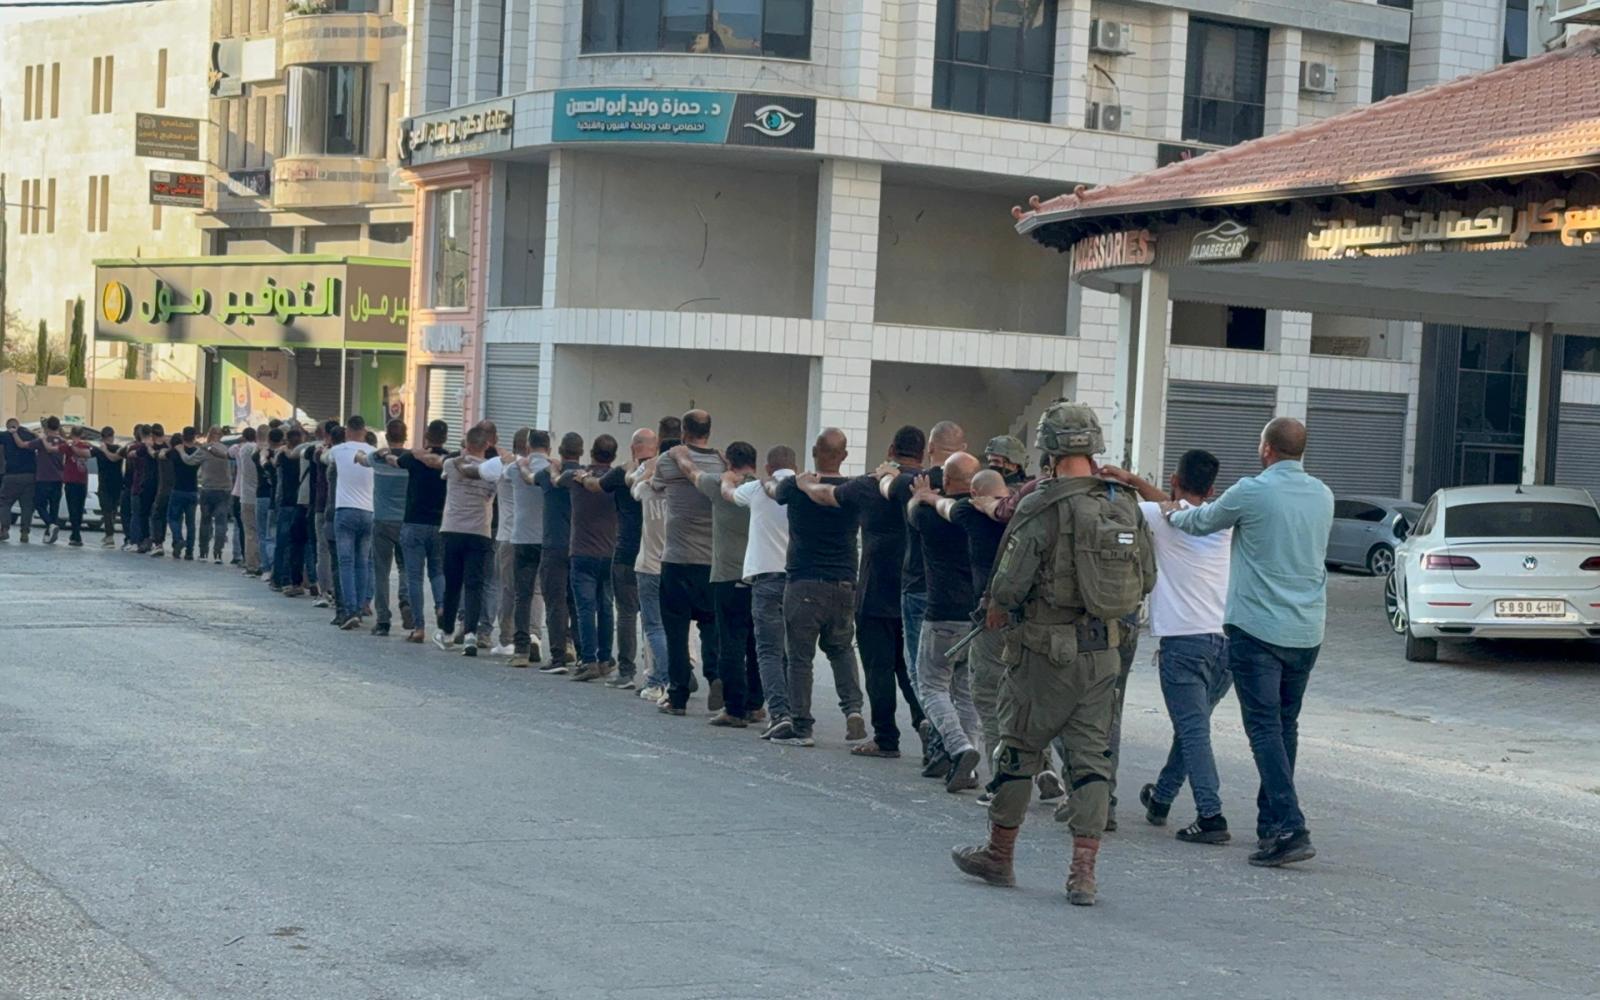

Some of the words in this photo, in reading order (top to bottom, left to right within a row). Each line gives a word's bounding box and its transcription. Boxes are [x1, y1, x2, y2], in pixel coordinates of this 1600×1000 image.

[566, 97, 605, 116] الحسن
[606, 93, 627, 116] أبو
[628, 97, 659, 116] وليد
[661, 98, 700, 117] حمزة
[139, 279, 208, 324] مول
[217, 277, 340, 325] التوفير
[350, 286, 389, 322] مول
